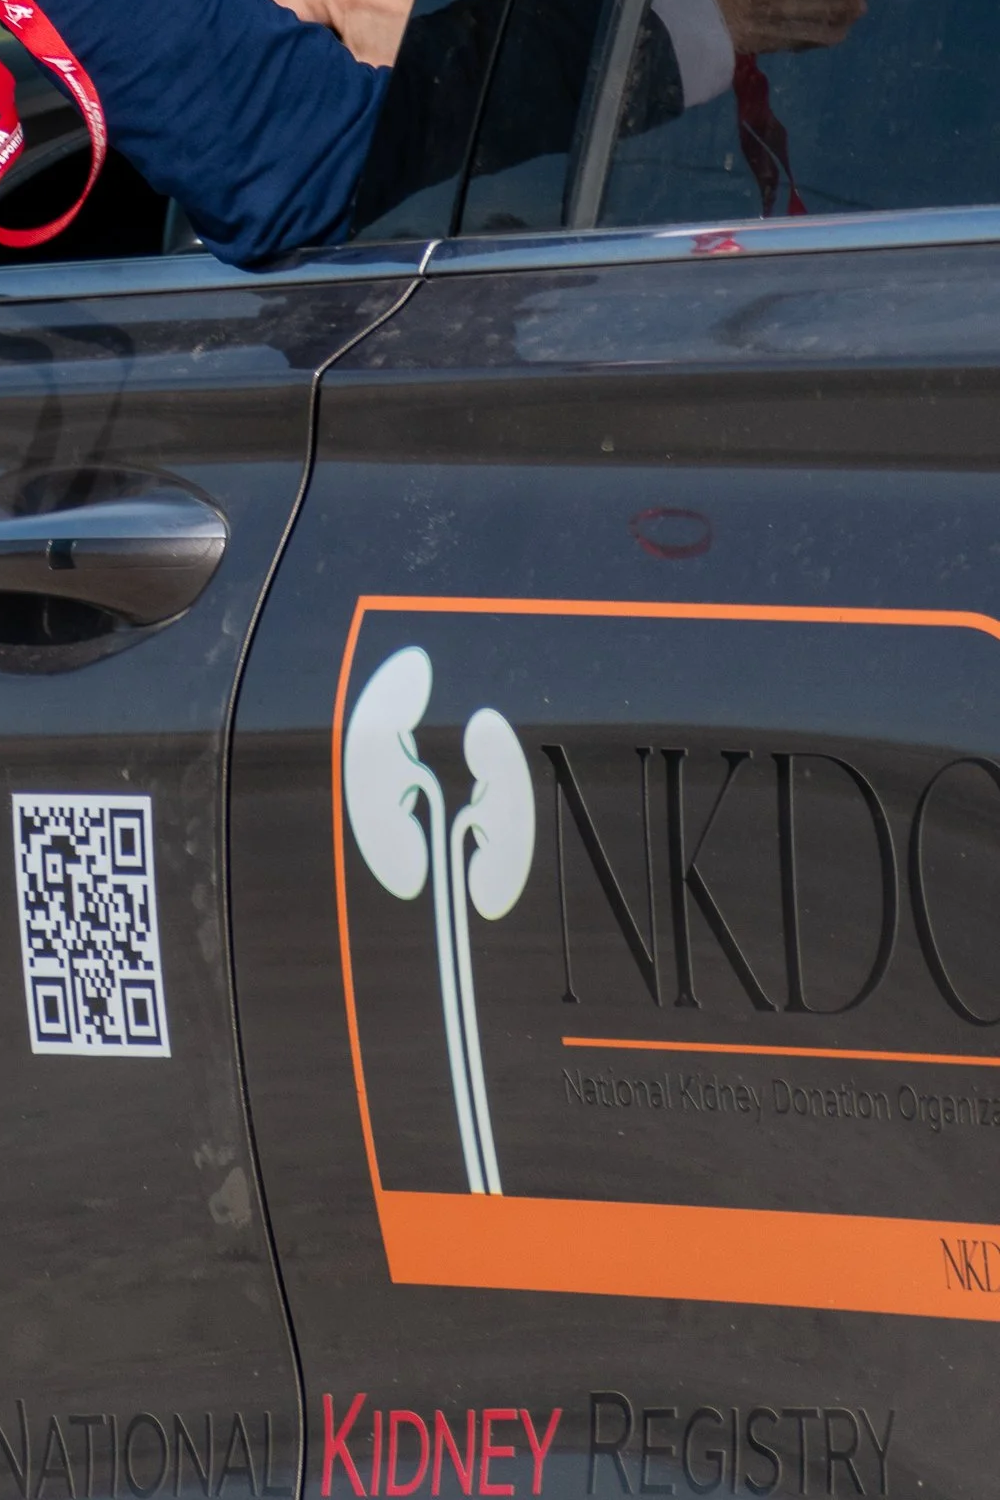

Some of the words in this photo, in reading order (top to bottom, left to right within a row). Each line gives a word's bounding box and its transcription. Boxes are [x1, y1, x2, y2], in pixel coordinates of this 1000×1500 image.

[541, 743, 1000, 1028] NKDO
[562, 1067, 673, 1110] National
[678, 1072, 763, 1124] Kidney
[771, 1077, 892, 1121] Donation
[320, 1392, 563, 1497] KIDNEY
[586, 1390, 897, 1496] REGISTRY
